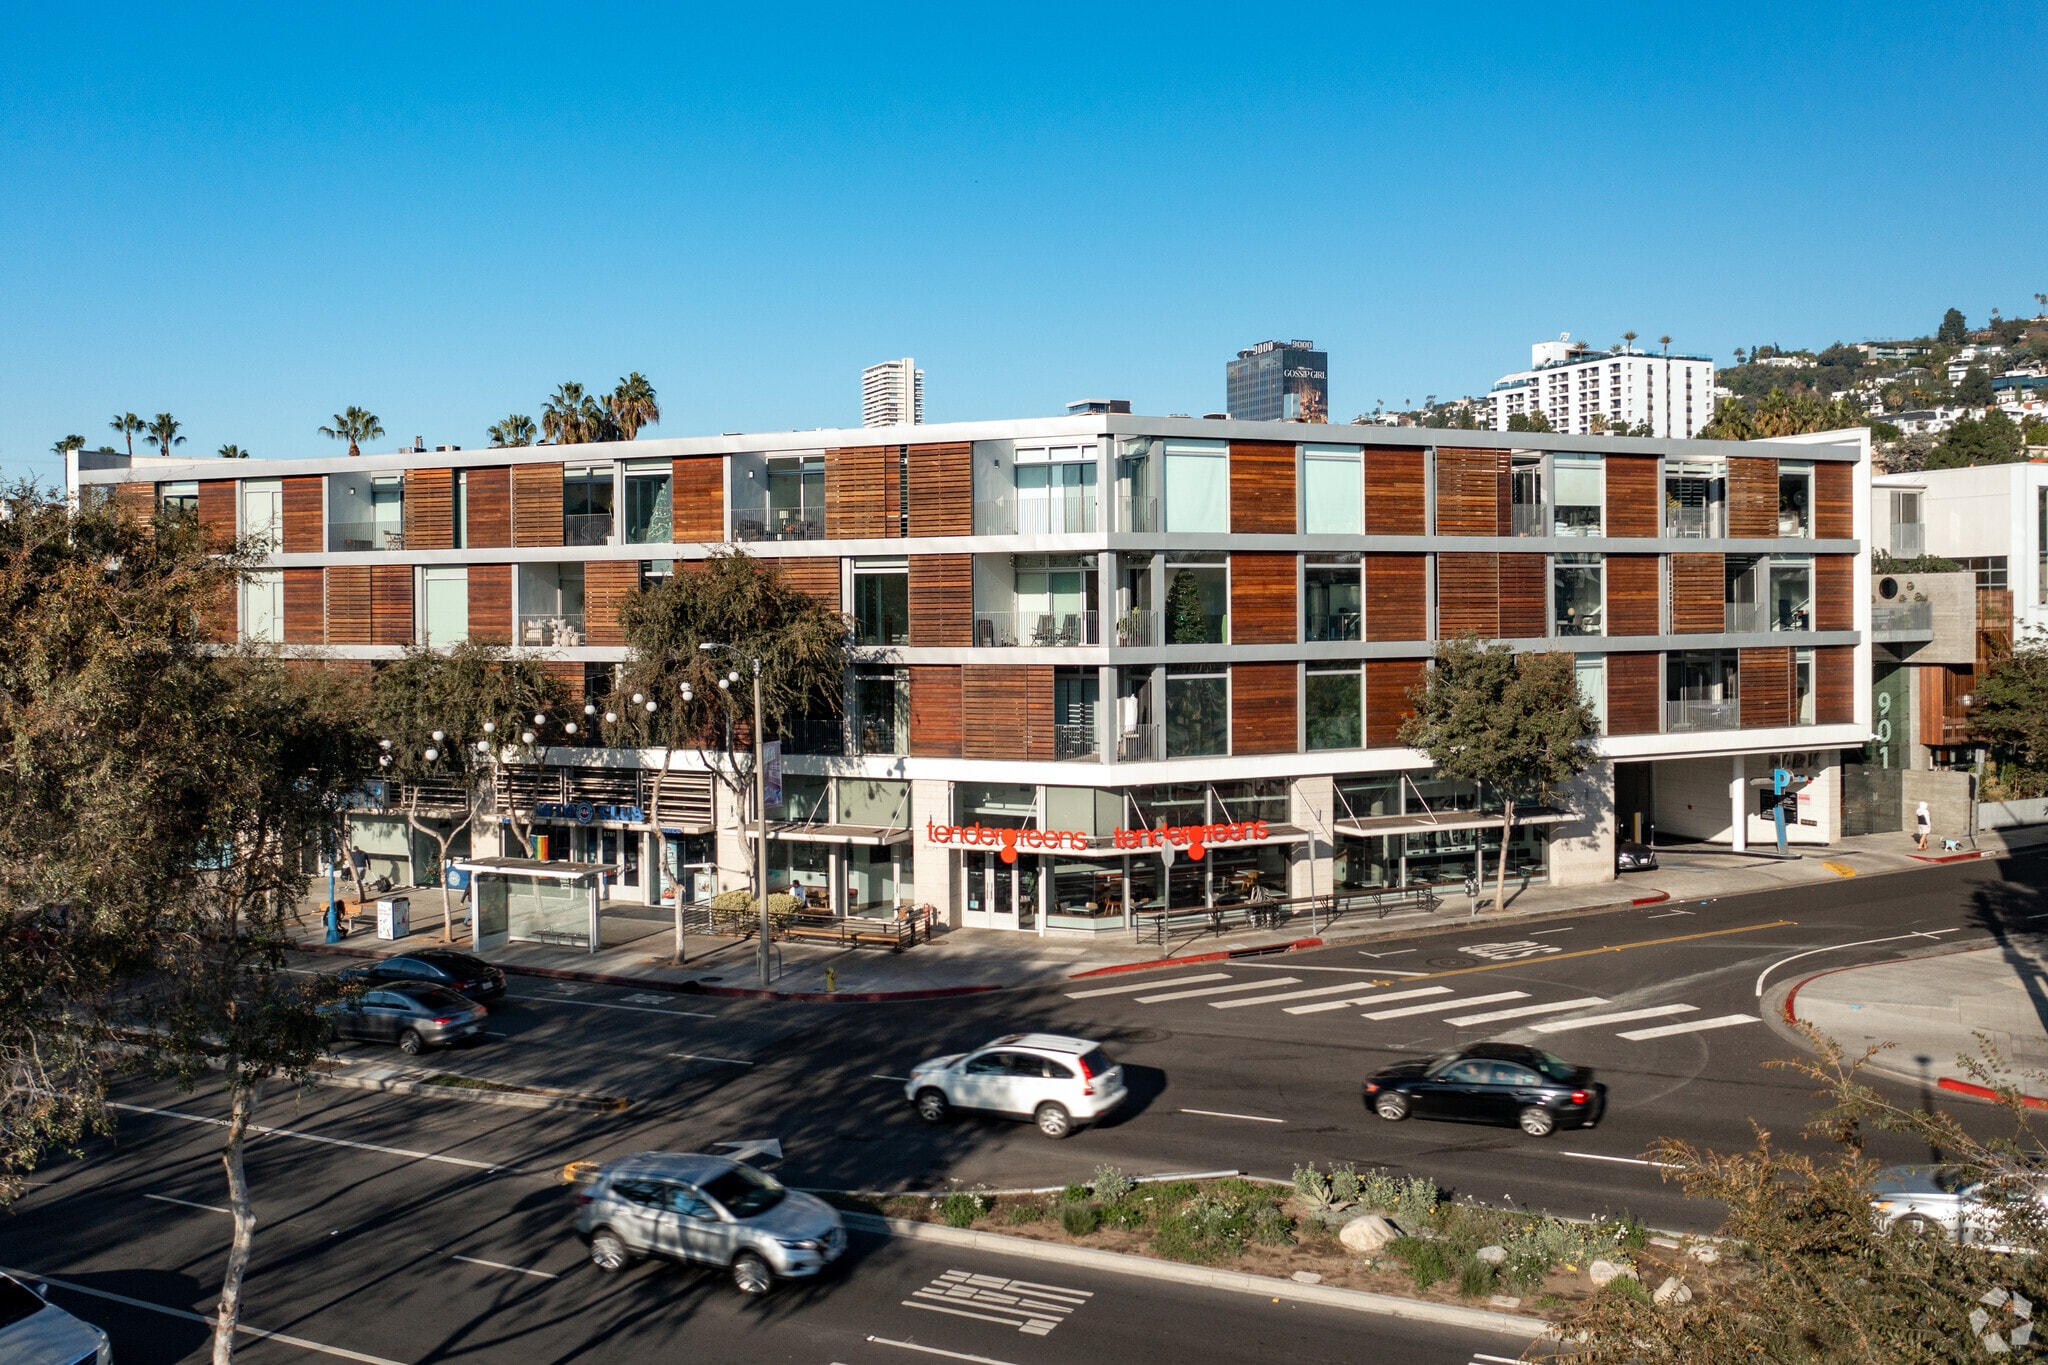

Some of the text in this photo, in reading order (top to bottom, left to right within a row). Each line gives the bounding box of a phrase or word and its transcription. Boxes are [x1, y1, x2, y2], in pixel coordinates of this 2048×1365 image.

[1291, 340, 1312, 349] 9000
[1283, 369, 1327, 379] GOSSIP GIRL
[1768, 751, 1822, 770] PARK
[1774, 768, 1794, 796] P
[597, 804, 644, 822] CLUB
[901, 1269, 1094, 1336] WAIT
